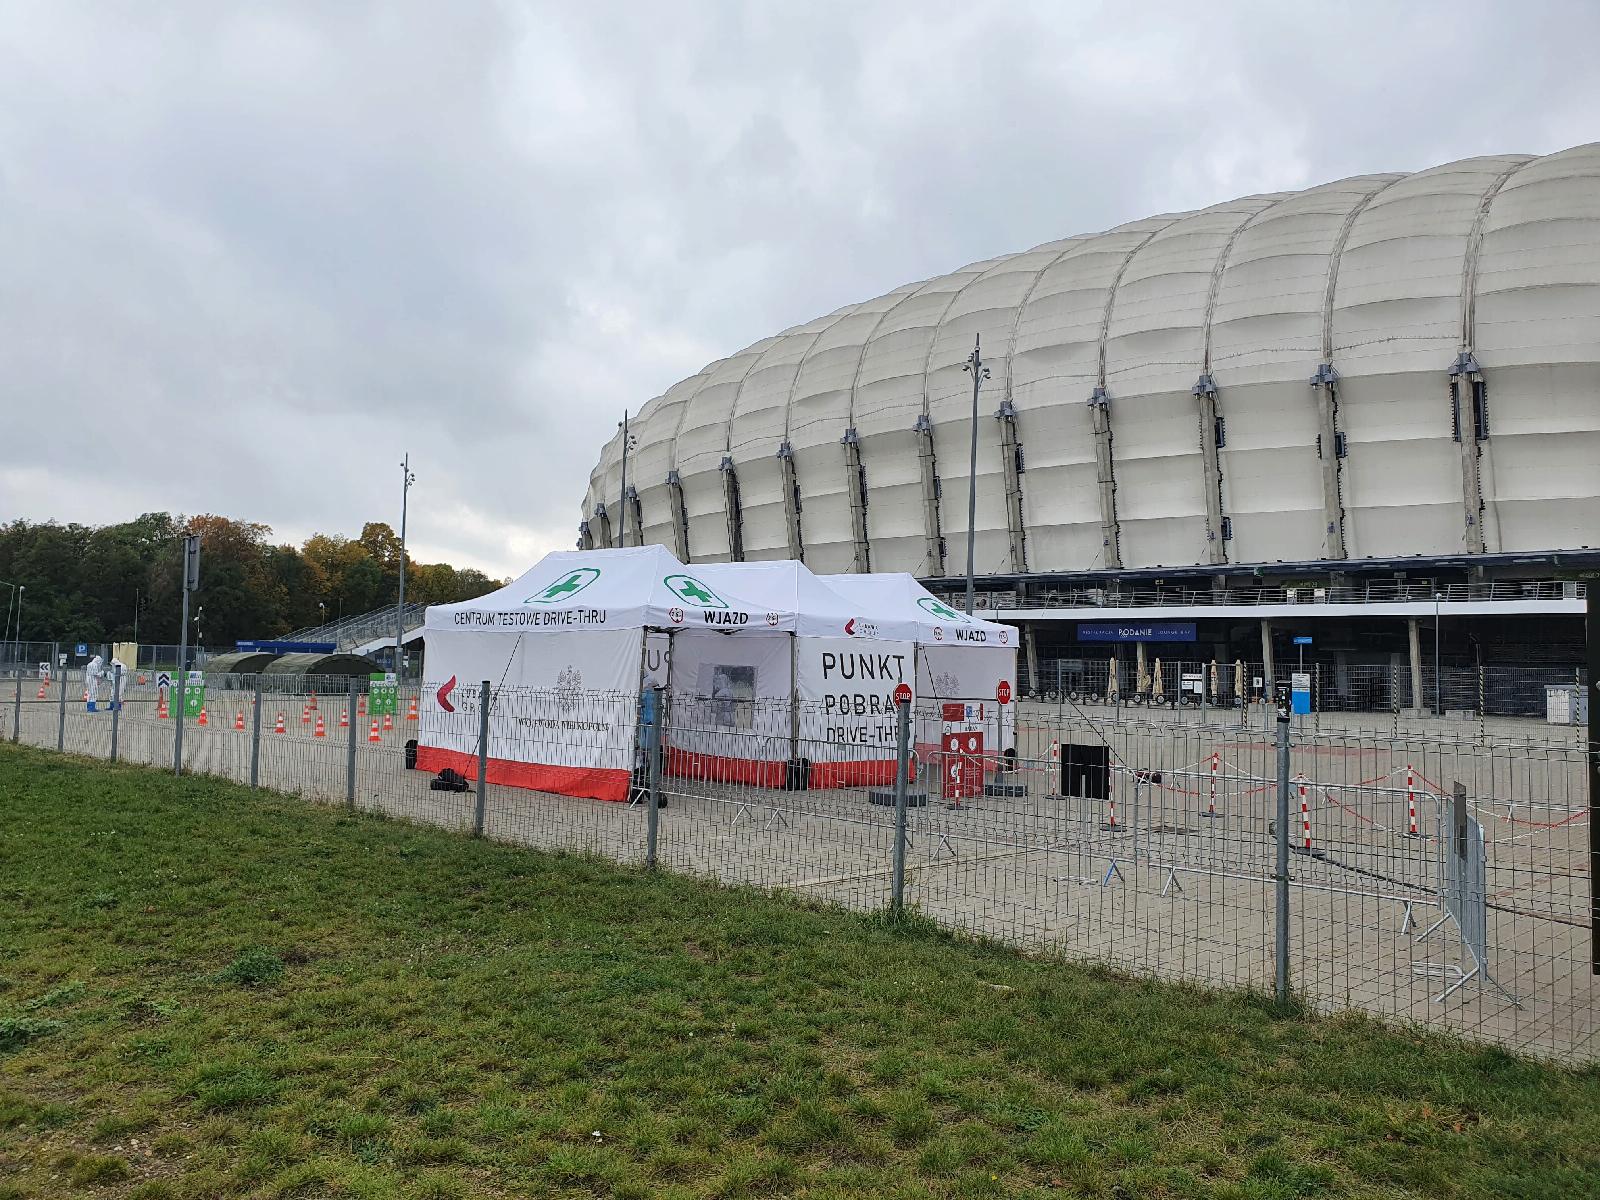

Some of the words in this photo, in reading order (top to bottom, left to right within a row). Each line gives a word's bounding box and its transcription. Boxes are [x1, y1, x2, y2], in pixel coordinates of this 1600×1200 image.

[454, 611, 496, 626] CENTRUM
[497, 612, 541, 626] TESTOWE
[543, 609, 607, 626] DRIVE-THRU
[703, 610, 749, 625] WJAZD
[955, 628, 987, 642] WJAZD
[1118, 628, 1152, 637] PODANIE
[78, 645, 86, 653] P
[822, 652, 905, 680] PUNKT
[895, 692, 911, 701] STOP
[998, 687, 1010, 697] STOP
[825, 693, 896, 715] POBRA
[826, 725, 899, 743] DRIVE-TH
